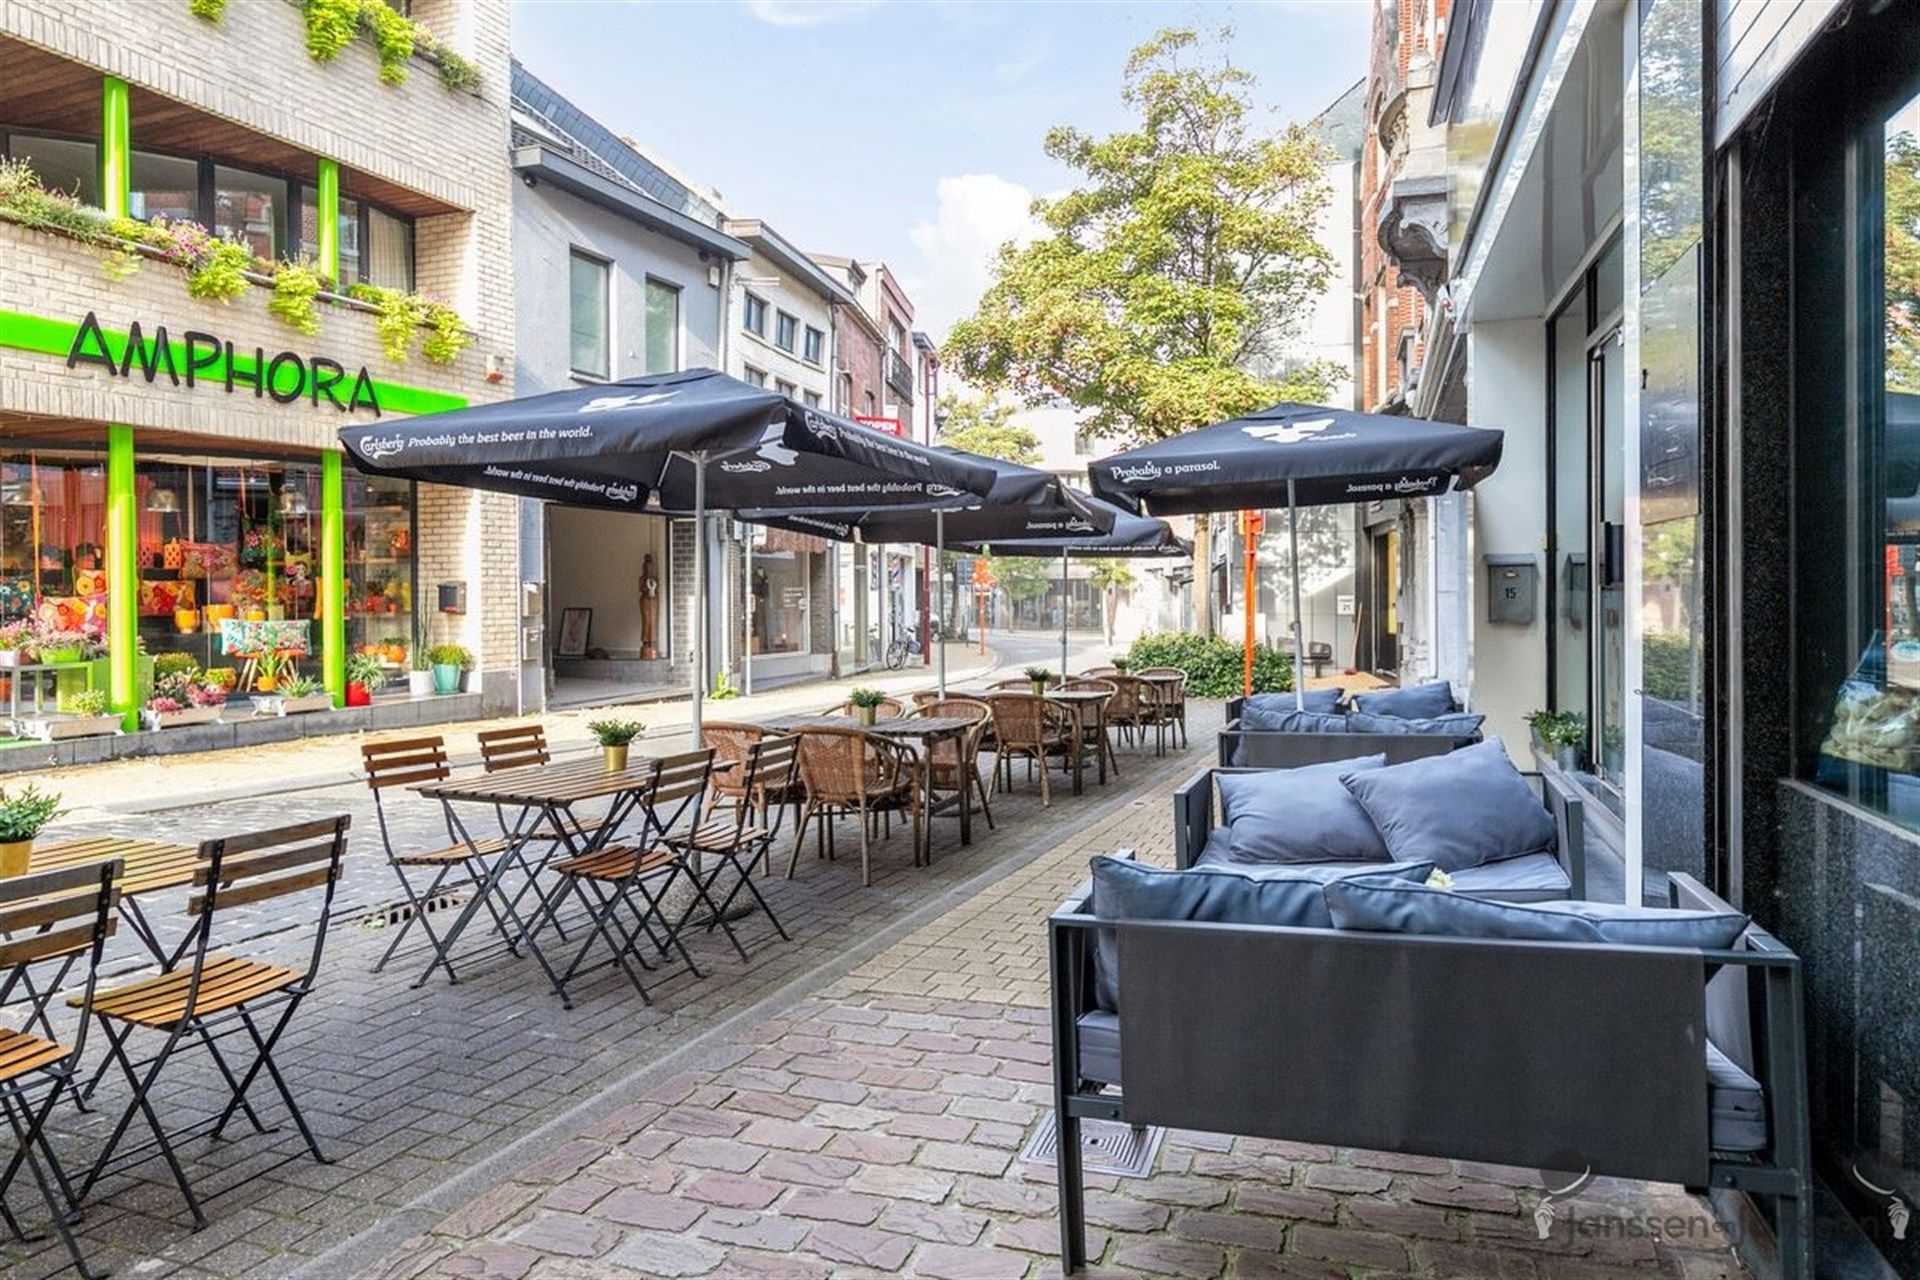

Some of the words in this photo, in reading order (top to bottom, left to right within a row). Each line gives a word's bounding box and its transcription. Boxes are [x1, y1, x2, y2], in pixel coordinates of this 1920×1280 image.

[67, 311, 381, 417] AMPHORA
[360, 433, 404, 460] Carlsberg
[408, 434, 456, 448] Probably
[457, 431, 475, 444] the
[476, 430, 499, 443] best
[501, 429, 524, 442] beer
[526, 430, 537, 440] in
[538, 428, 556, 439] the
[558, 426, 593, 438] world.
[1110, 461, 1161, 483] Probably
[1164, 466, 1172, 474] a
[1175, 460, 1221, 475] parasol.
[1504, 587, 1517, 599] 15
